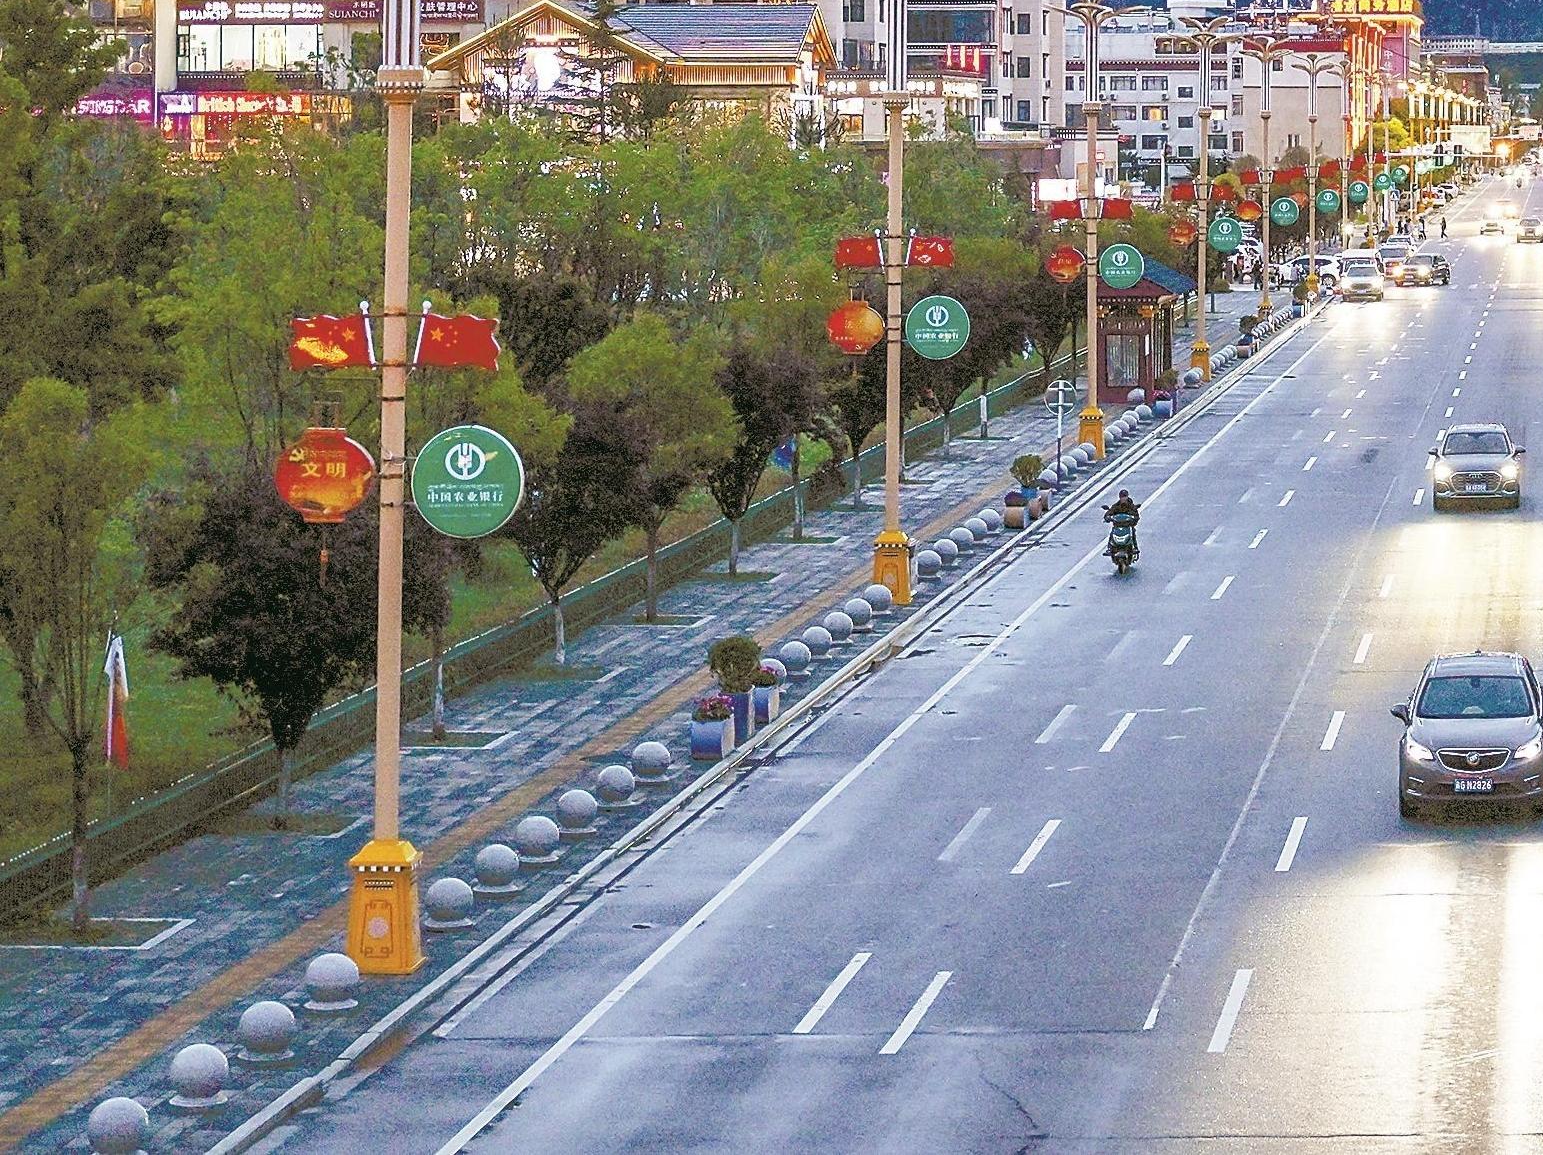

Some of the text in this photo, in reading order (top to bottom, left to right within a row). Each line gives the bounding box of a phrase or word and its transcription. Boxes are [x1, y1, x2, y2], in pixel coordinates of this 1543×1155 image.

[301, 461, 346, 478] 文明
[427, 491, 504, 503] 中国农业银行
